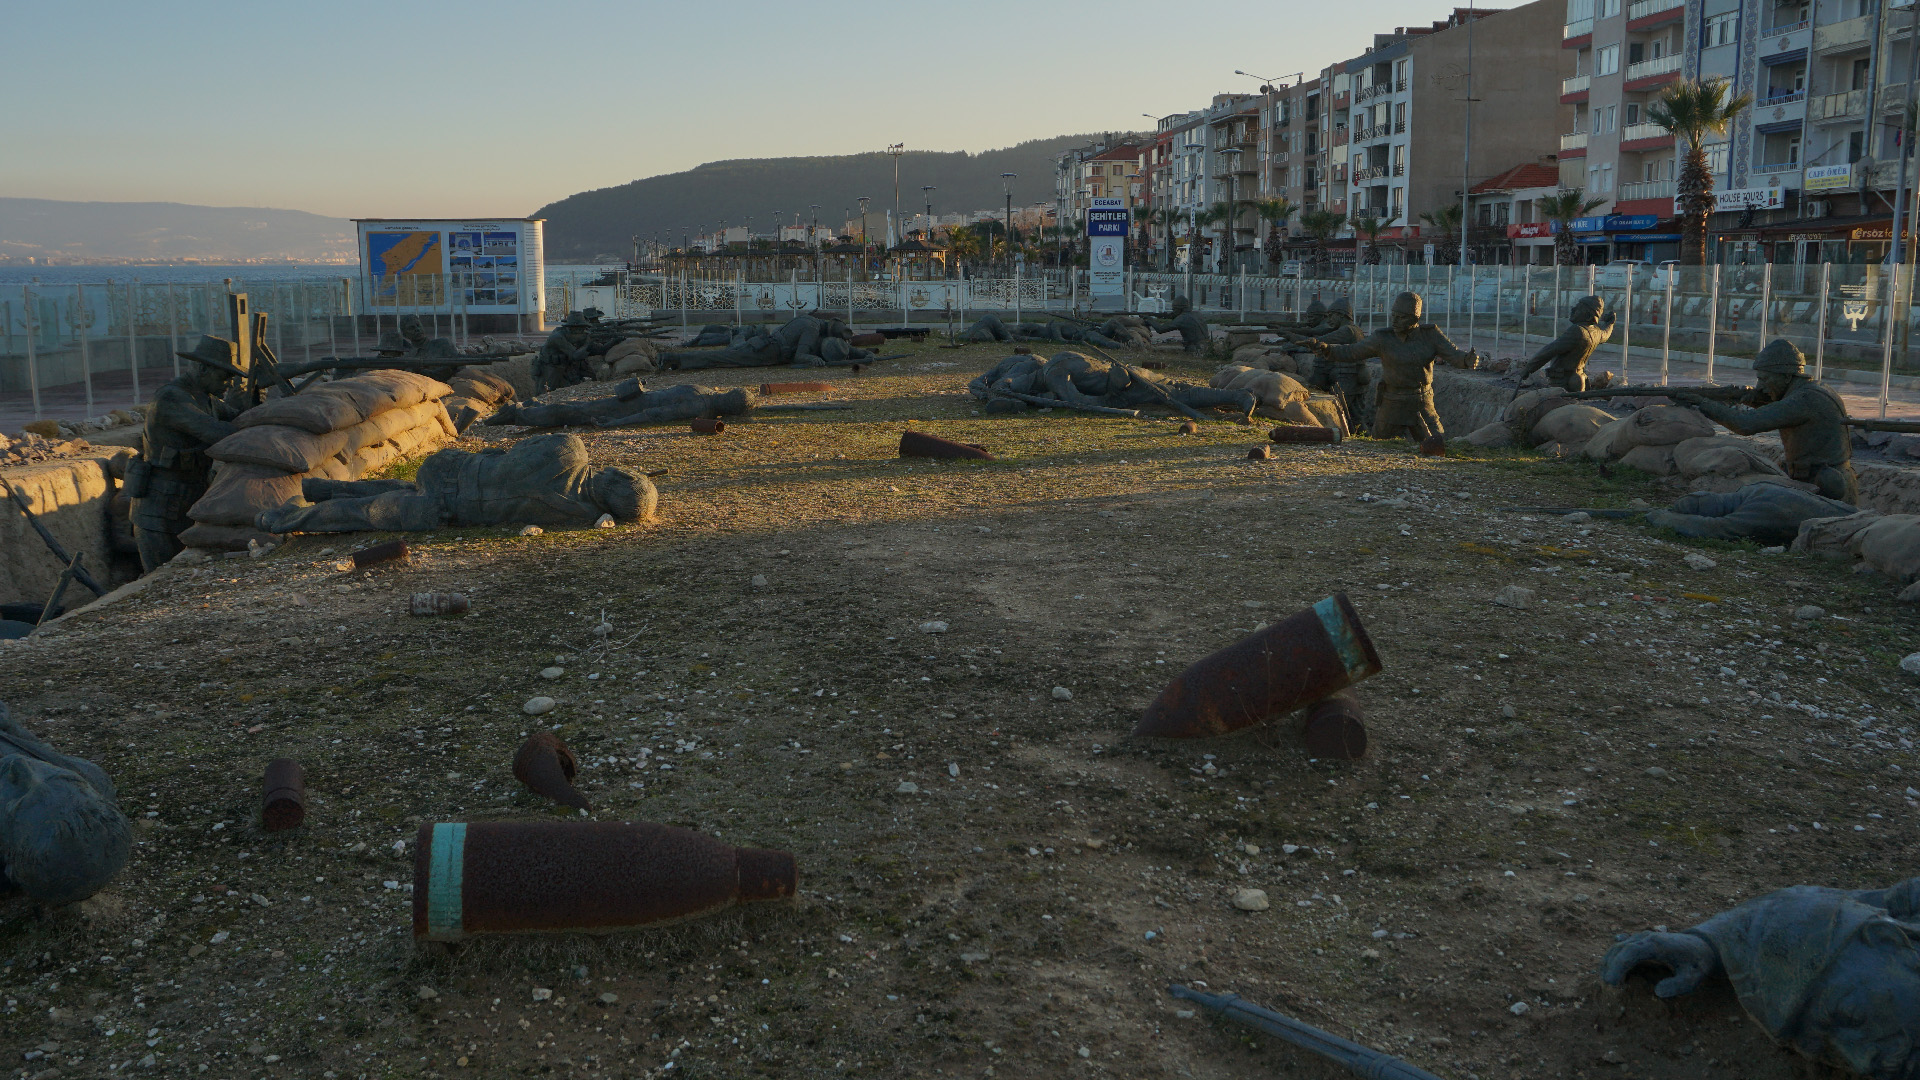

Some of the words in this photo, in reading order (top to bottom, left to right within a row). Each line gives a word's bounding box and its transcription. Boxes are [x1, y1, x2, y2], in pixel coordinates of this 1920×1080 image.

[1808, 169, 1825, 179] CAFE
[1719, 192, 1741, 203] HOUSE
[1742, 190, 1764, 202] TOURS
[1090, 210, 1127, 223] ŞEHİTLER
[1098, 223, 1120, 232] PARKI
